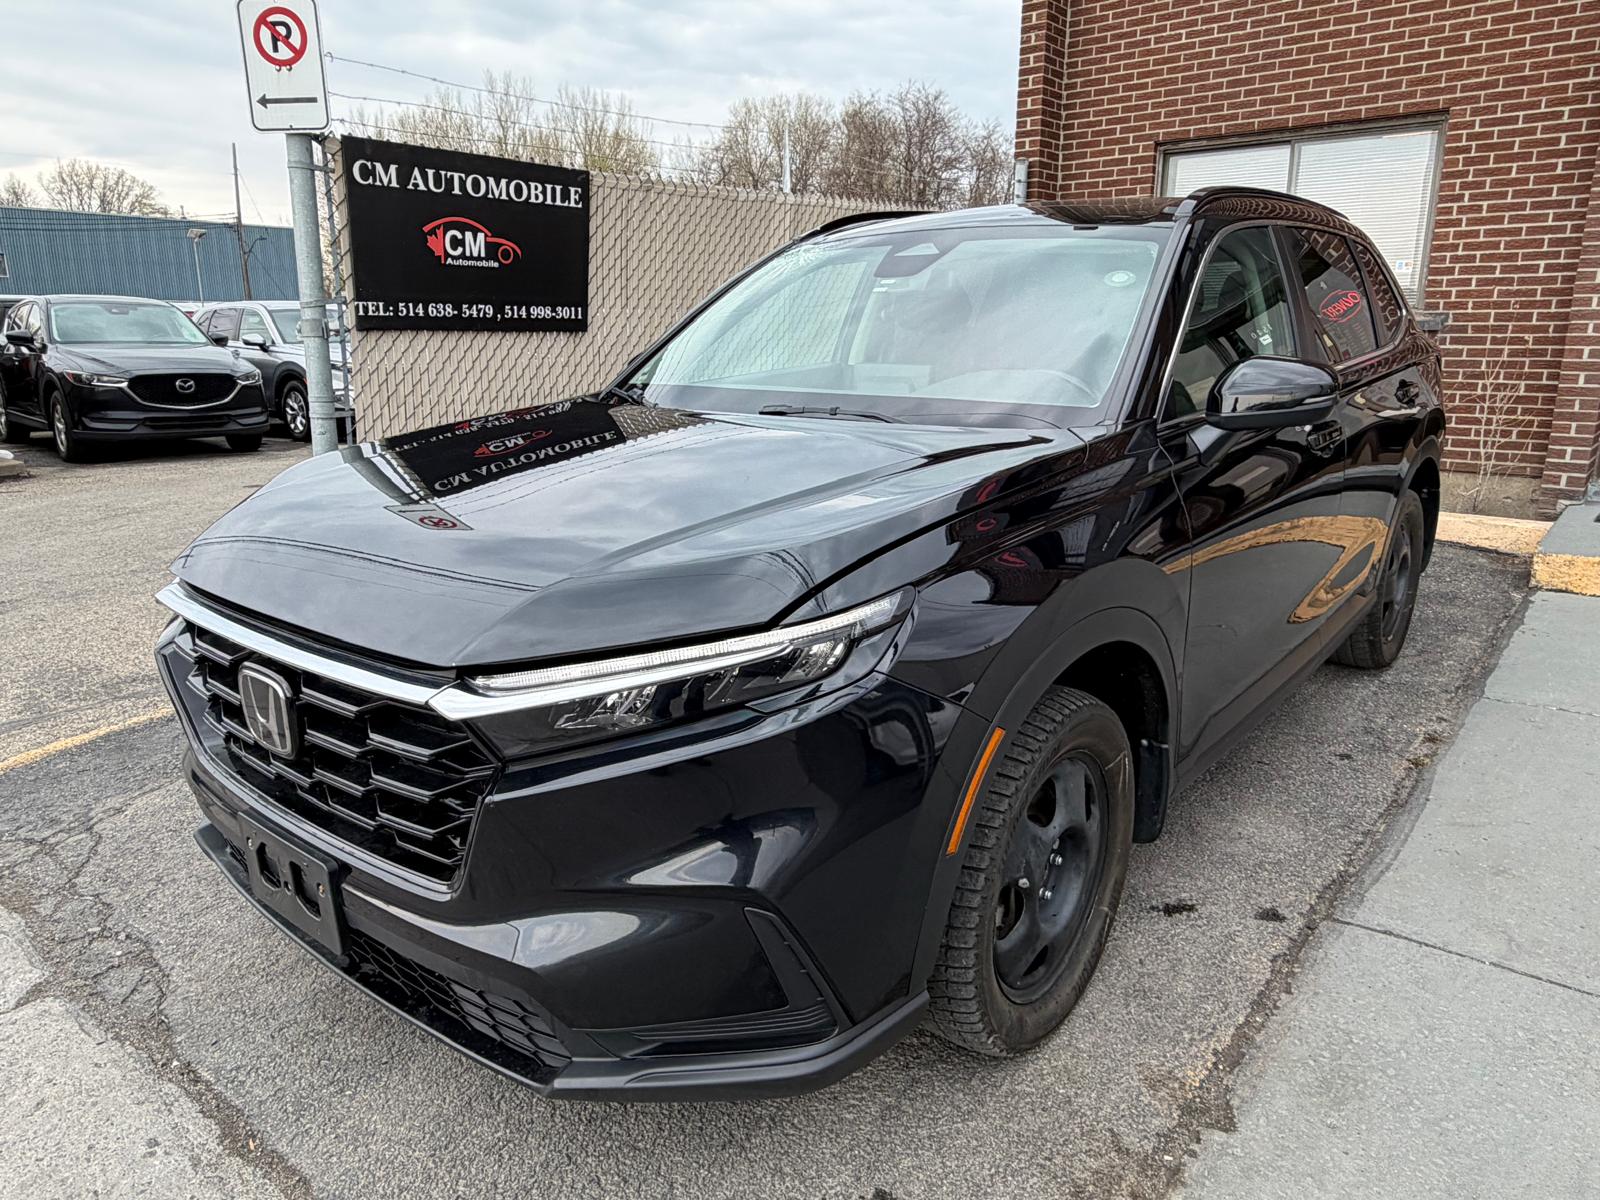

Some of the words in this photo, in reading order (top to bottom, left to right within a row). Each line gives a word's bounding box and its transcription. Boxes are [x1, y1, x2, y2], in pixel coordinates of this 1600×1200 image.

[352, 159, 400, 188] CM
[406, 166, 583, 208] AUTOMOBILE
[444, 229, 486, 257] CM
[446, 257, 499, 268] Automobile
[355, 301, 394, 317] TEL:
[398, 302, 424, 317] 514
[461, 304, 494, 318] 5479
[504, 305, 527, 319] 514
[530, 305, 583, 319] 998-3011
